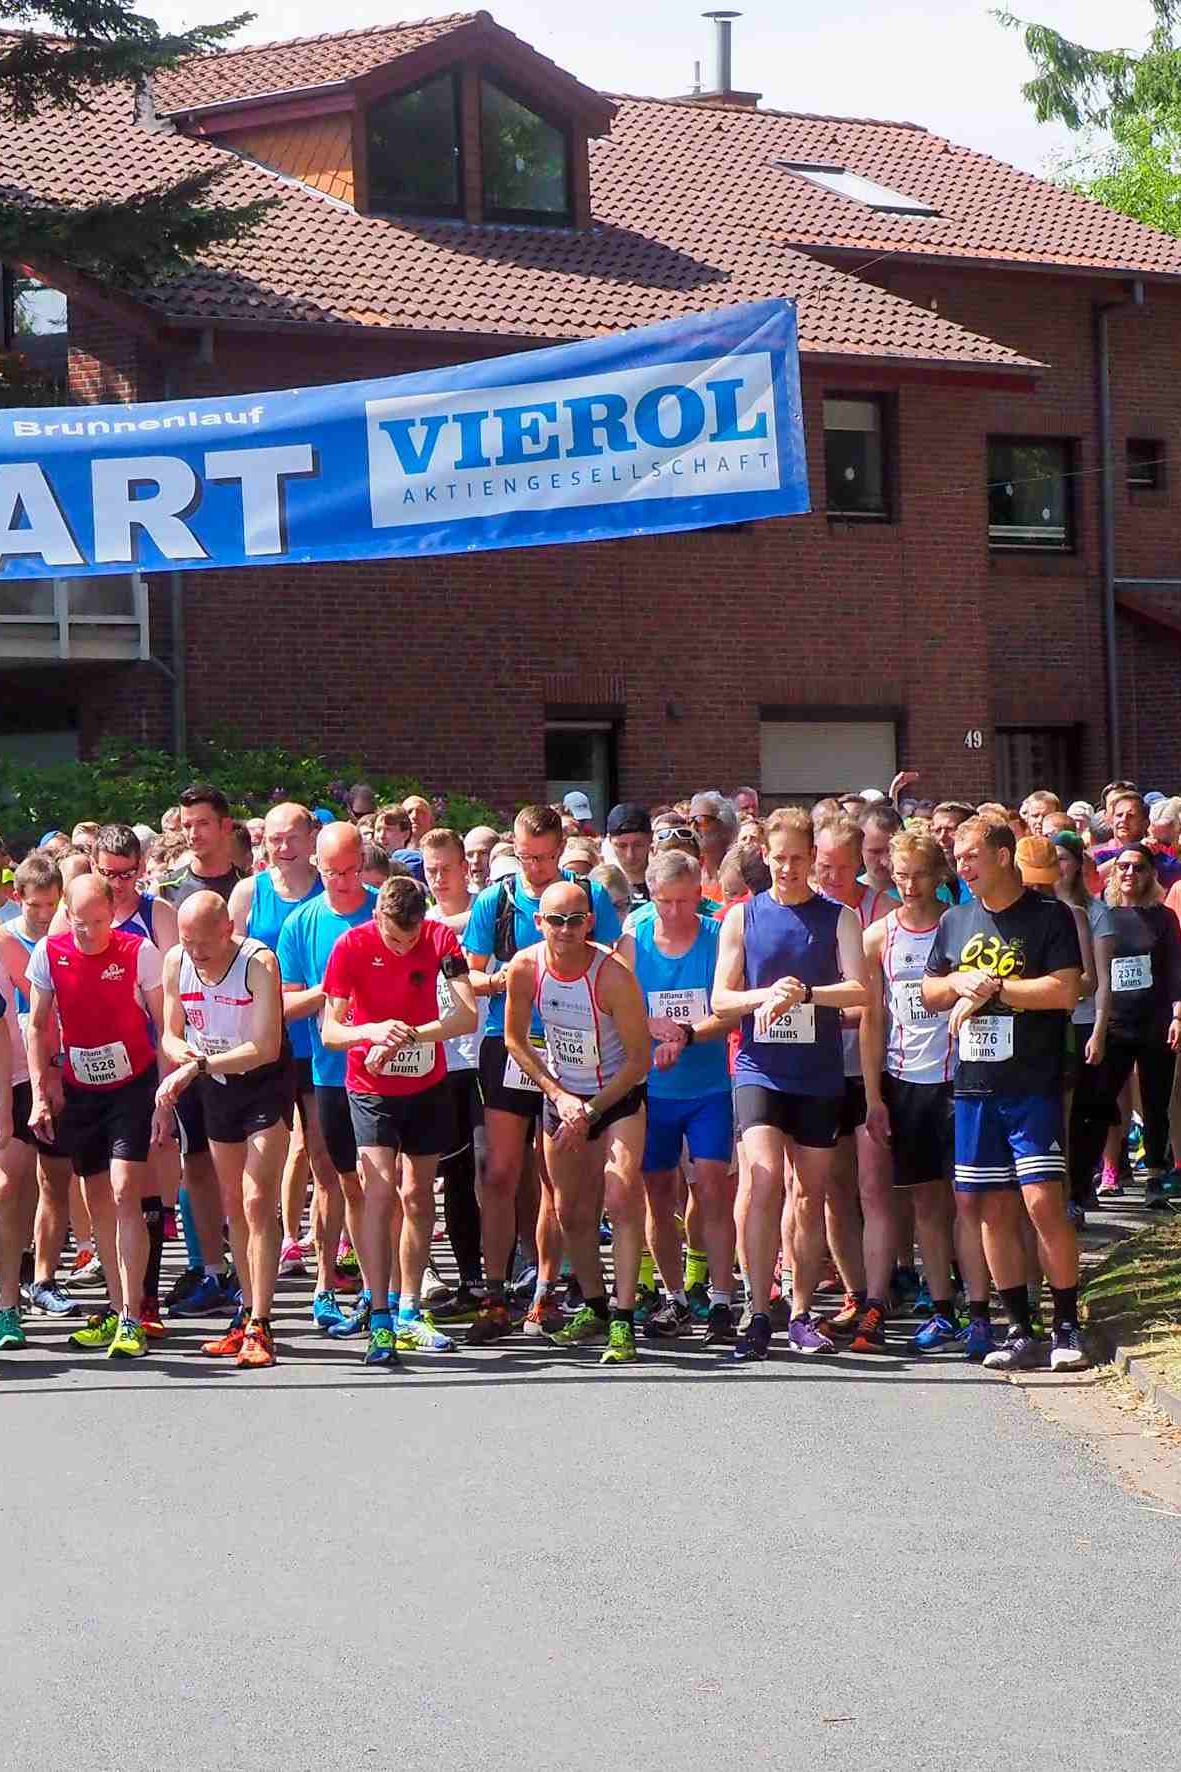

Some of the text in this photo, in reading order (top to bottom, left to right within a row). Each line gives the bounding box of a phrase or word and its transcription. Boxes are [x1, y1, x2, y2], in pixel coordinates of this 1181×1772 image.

[13, 406, 266, 438] Brunnenlauf
[379, 378, 768, 476] VIEROL
[403, 452, 772, 505] AKTIENGESELLSCHAFT
[964, 730, 982, 748] 49
[666, 1006, 689, 1018] 688
[770, 1027, 799, 1039] bruns
[969, 1032, 998, 1045] 2276
[555, 1040, 584, 1055] 2104
[84, 1059, 116, 1073] 1528
[390, 1062, 419, 1073] bruns
